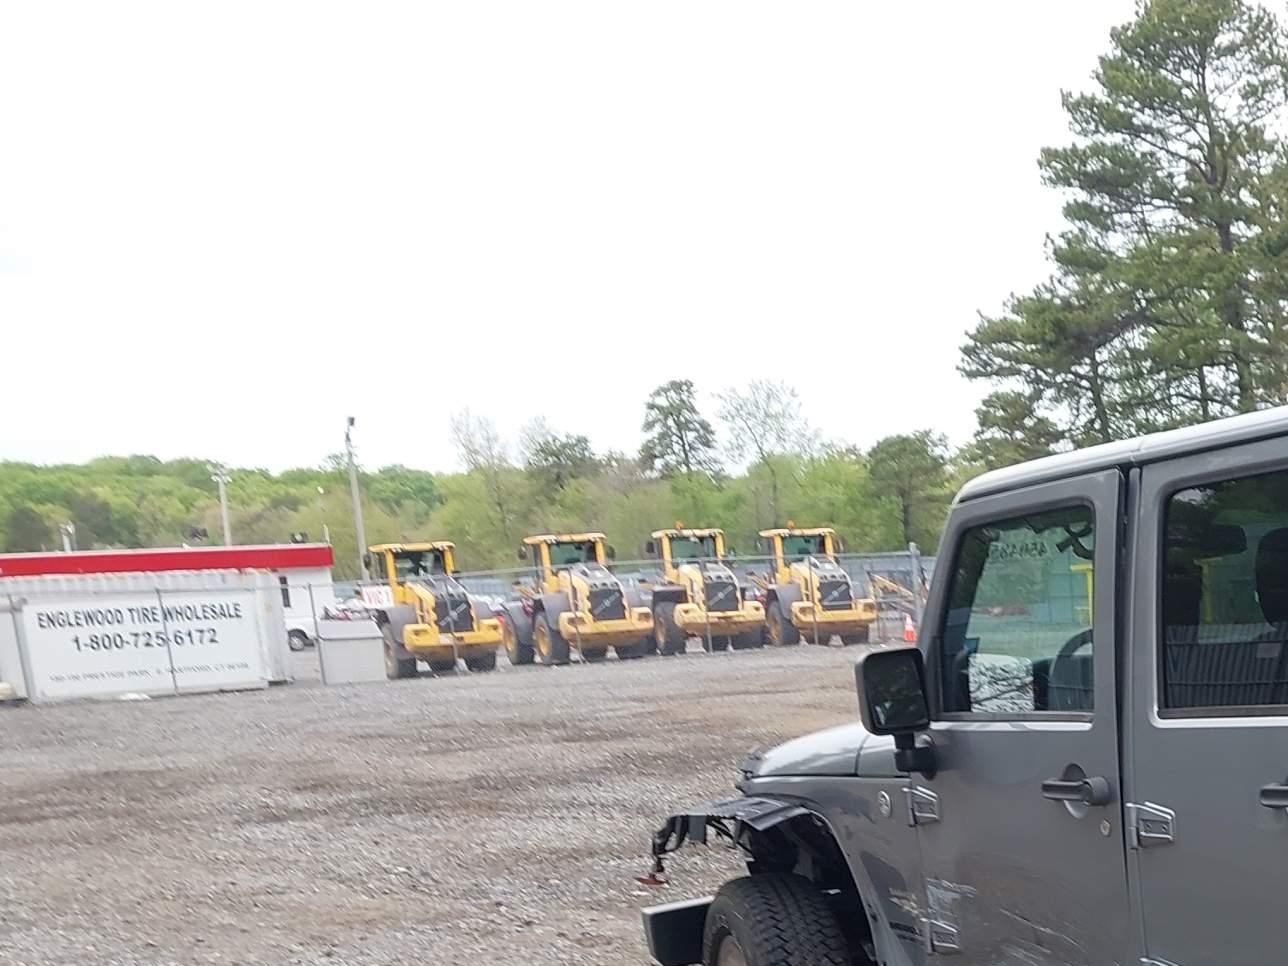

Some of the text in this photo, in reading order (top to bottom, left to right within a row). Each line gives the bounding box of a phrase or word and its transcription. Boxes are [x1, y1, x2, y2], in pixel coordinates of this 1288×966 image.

[37, 603, 244, 629] ENGLEWOOD TIRE WHOLESALE
[71, 627, 219, 653] 1-800-725-6172
